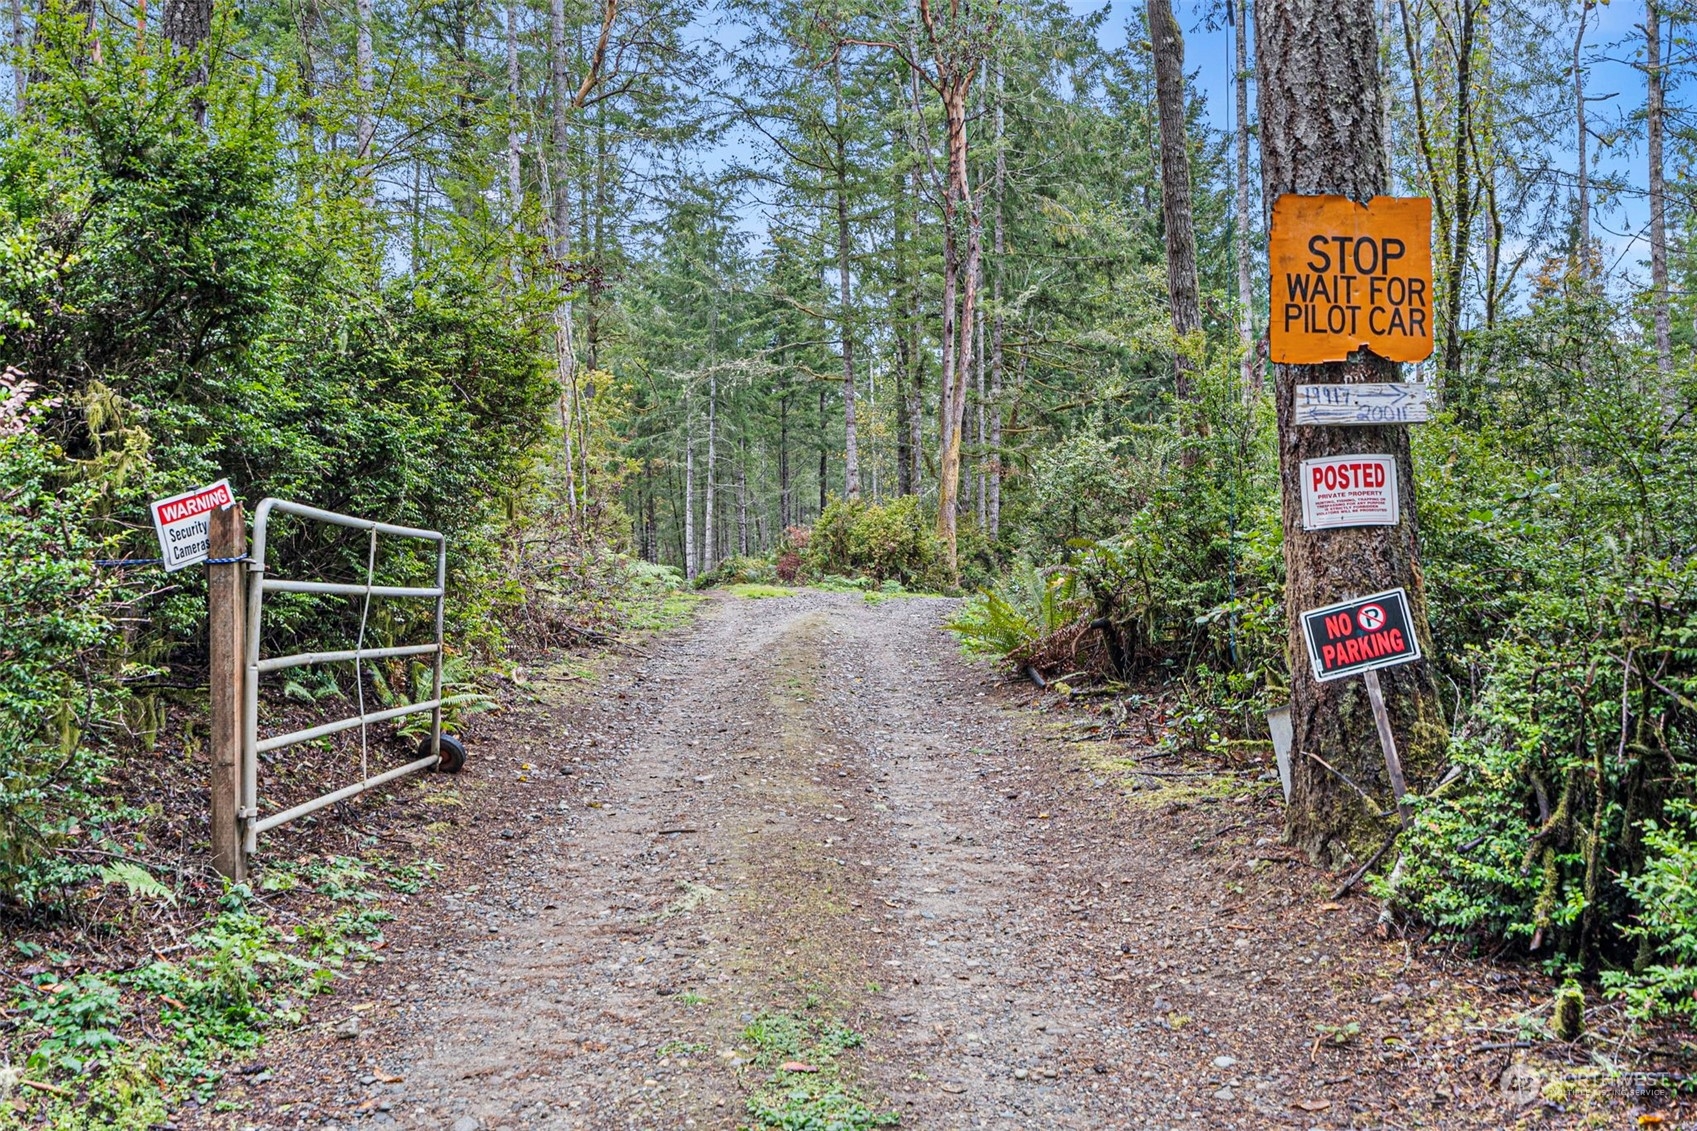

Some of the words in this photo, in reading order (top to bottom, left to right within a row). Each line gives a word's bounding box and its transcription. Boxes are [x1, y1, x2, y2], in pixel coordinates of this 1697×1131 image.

[1307, 235, 1406, 275] STOP
[1286, 273, 1357, 304] WAIT
[1369, 276, 1426, 307] FOR
[1284, 303, 1361, 335] PILOT
[1369, 306, 1426, 337] CAR
[1312, 463, 1385, 492] POSTED
[162, 488, 228, 522] WARNING
[1317, 492, 1346, 500] PRIVATE
[169, 521, 207, 543] Security
[173, 538, 211, 560] Cameras
[1324, 612, 1352, 640] NO
[1322, 628, 1406, 669] PARKING
